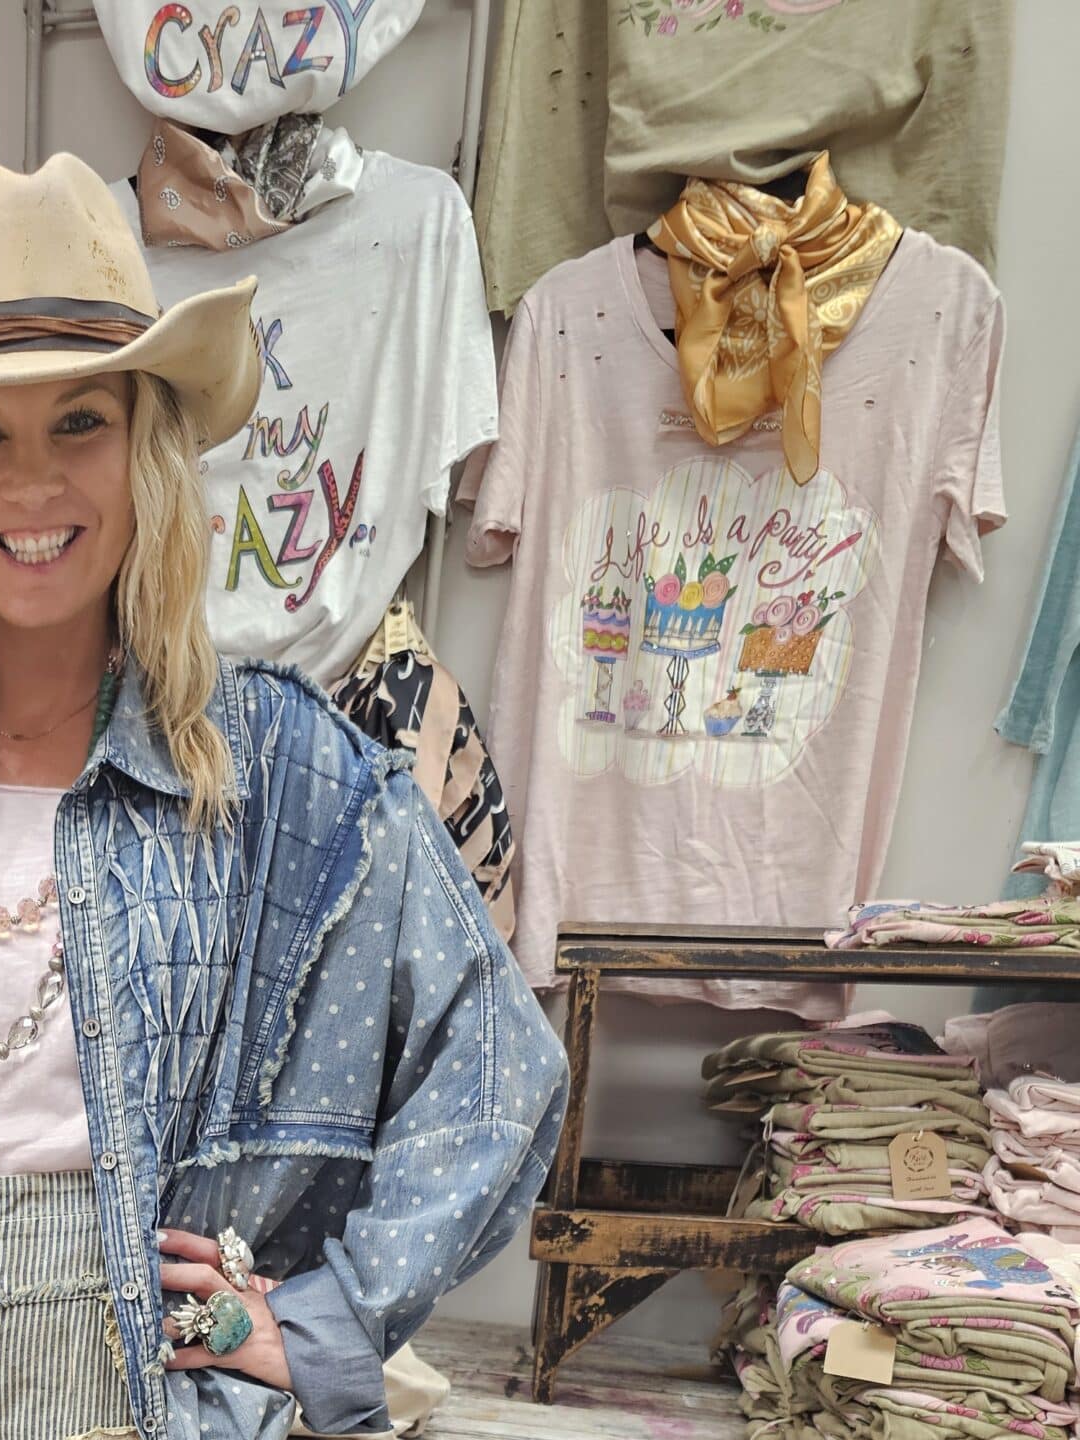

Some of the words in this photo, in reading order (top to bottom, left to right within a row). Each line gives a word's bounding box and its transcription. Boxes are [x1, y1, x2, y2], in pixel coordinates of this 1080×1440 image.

[143, 0, 376, 99] CRAZY
[241, 402, 329, 491] my
[211, 448, 366, 613] AZY
[590, 511, 670, 583] Life
